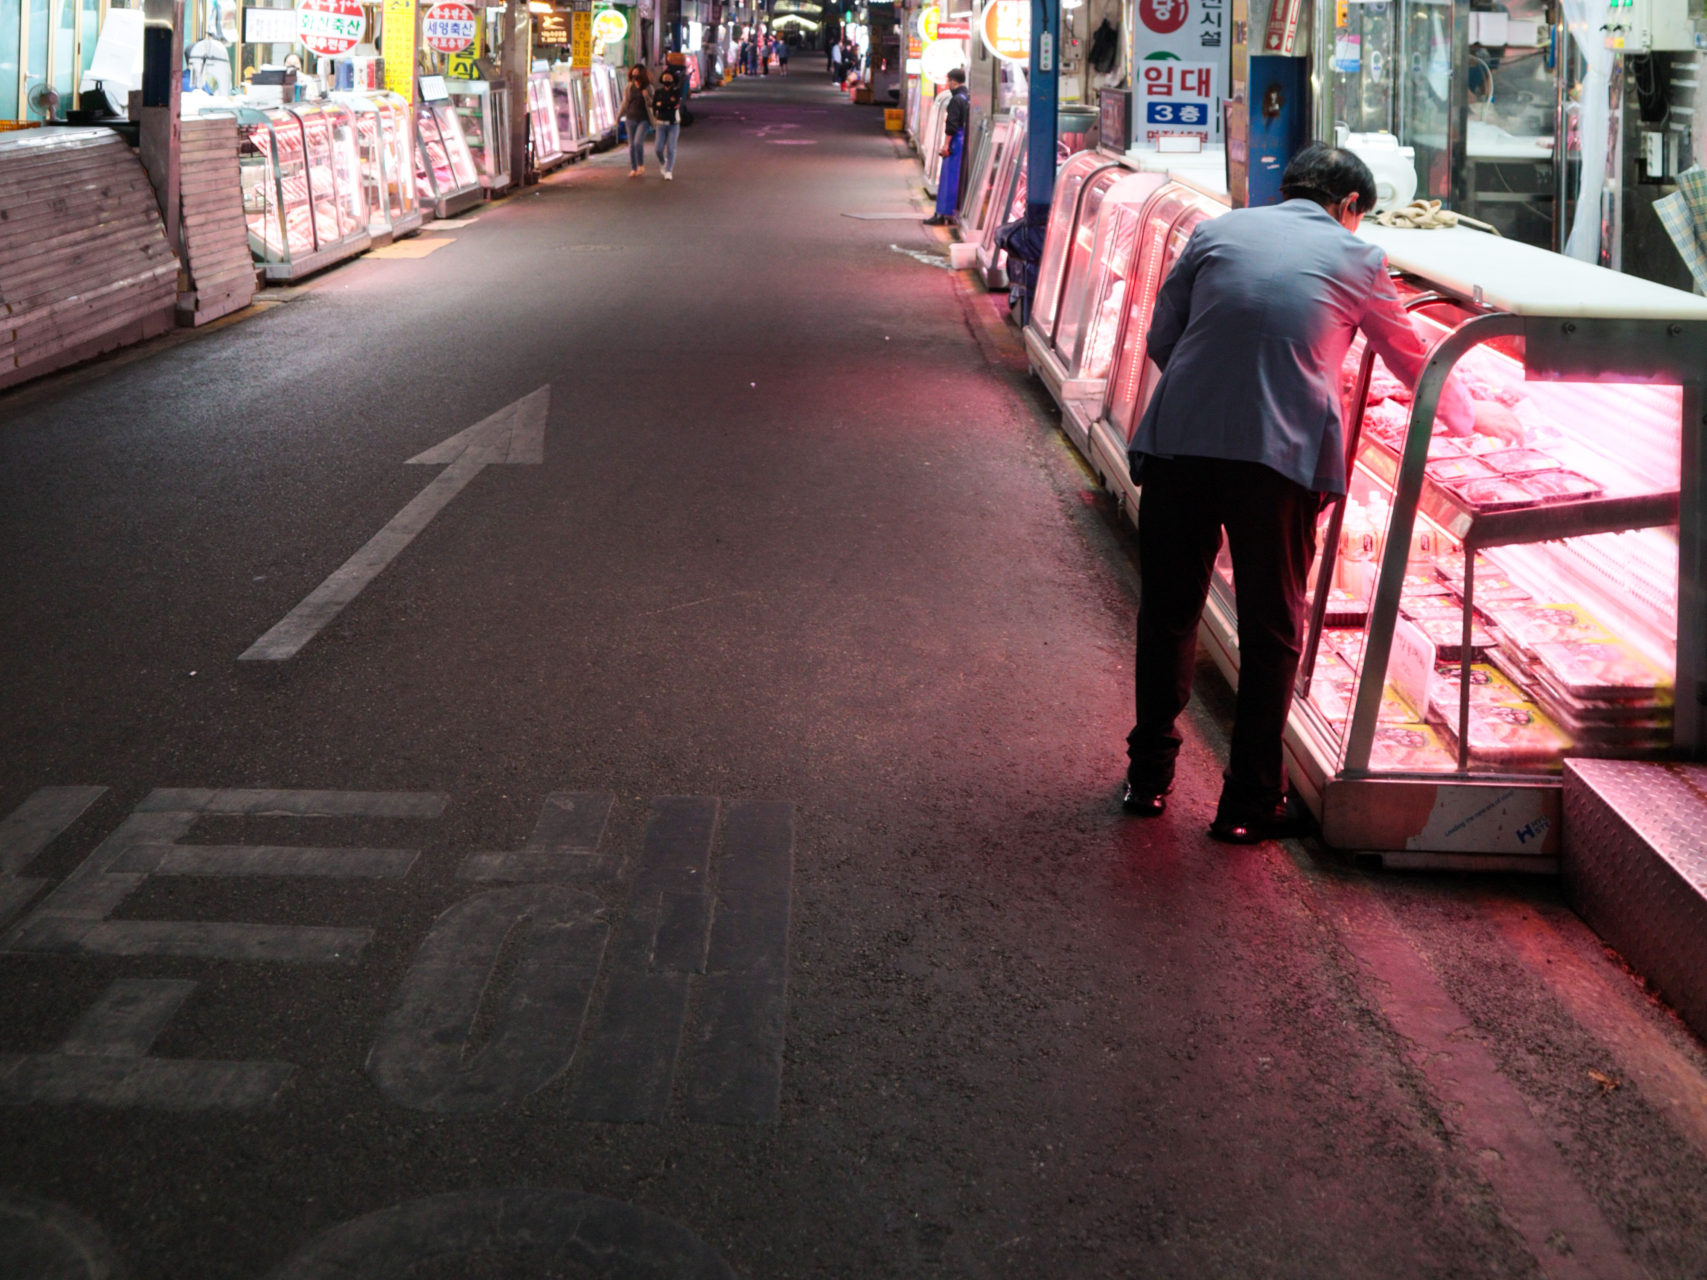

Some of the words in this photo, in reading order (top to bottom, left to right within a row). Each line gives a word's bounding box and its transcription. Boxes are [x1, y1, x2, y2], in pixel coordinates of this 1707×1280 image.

[302, 14, 361, 37] 화신축산
[427, 21, 473, 37] 세영축산
[1144, 66, 1211, 98] 임대
